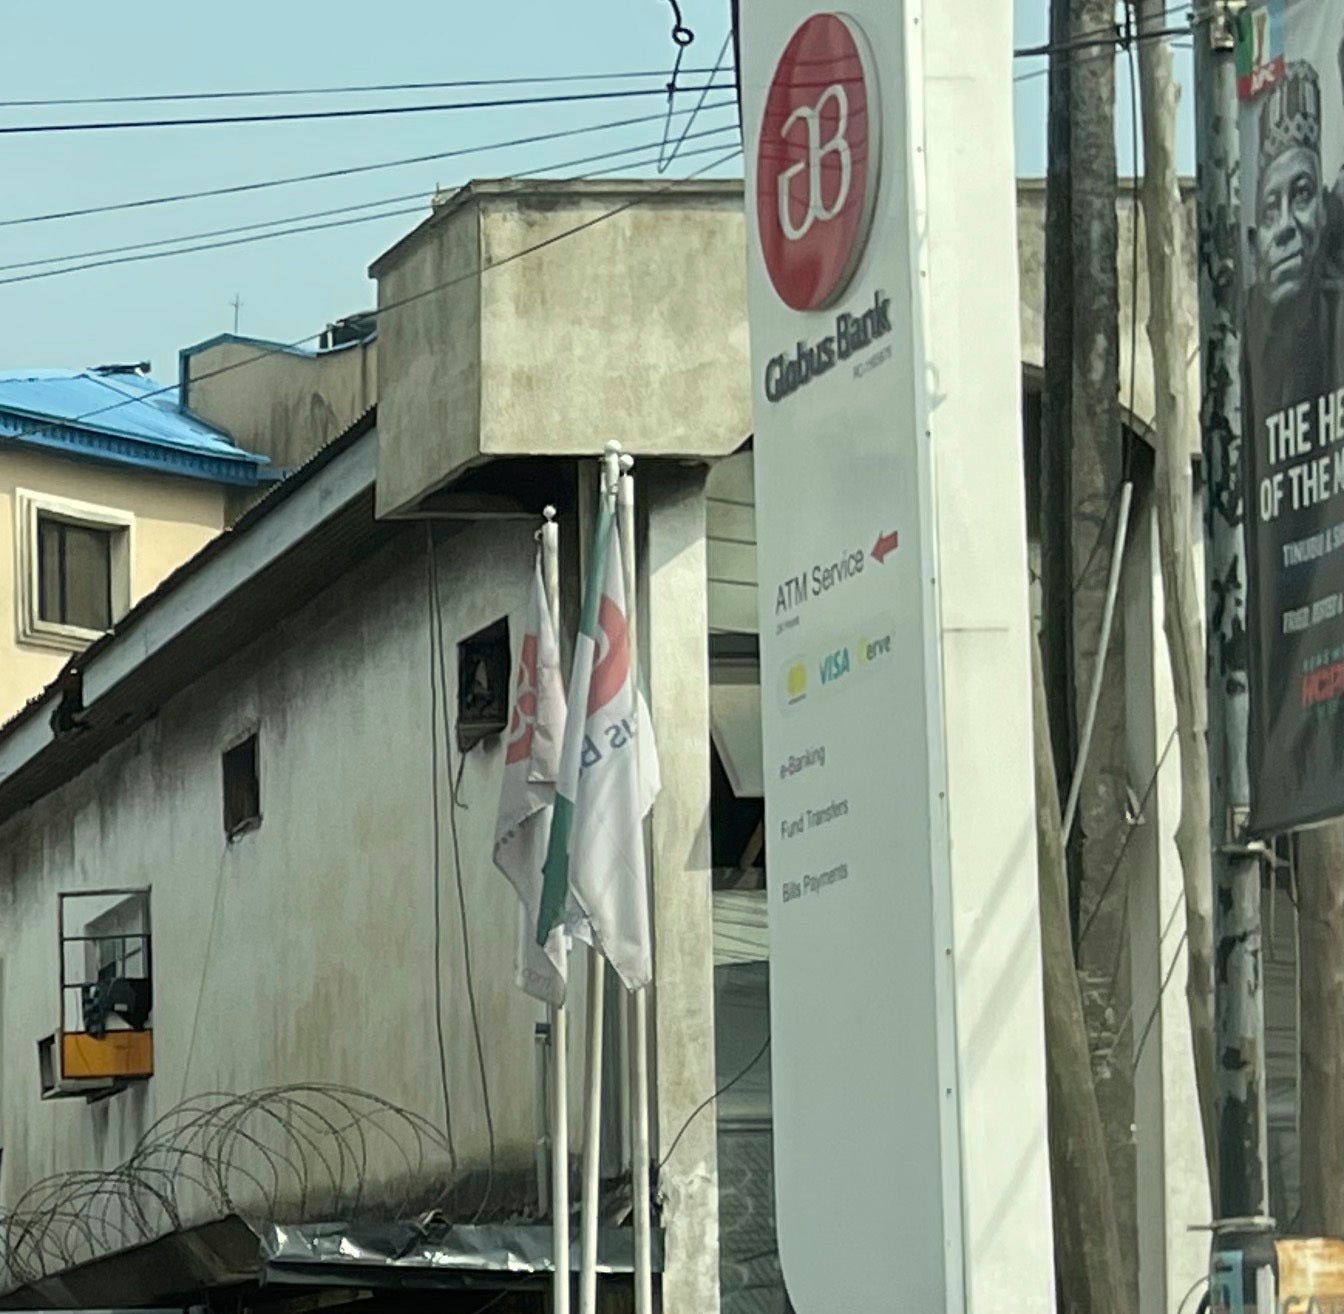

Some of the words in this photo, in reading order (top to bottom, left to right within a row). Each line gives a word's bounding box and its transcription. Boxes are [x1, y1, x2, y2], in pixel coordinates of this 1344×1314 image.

[765, 337, 835, 403] Globus
[835, 290, 892, 361] Bank
[1265, 401, 1312, 466] THE
[1260, 472, 1284, 522] OF
[1288, 456, 1330, 511] THE
[775, 572, 808, 615] ATM
[811, 549, 865, 596] Service
[819, 647, 850, 685] VISA
